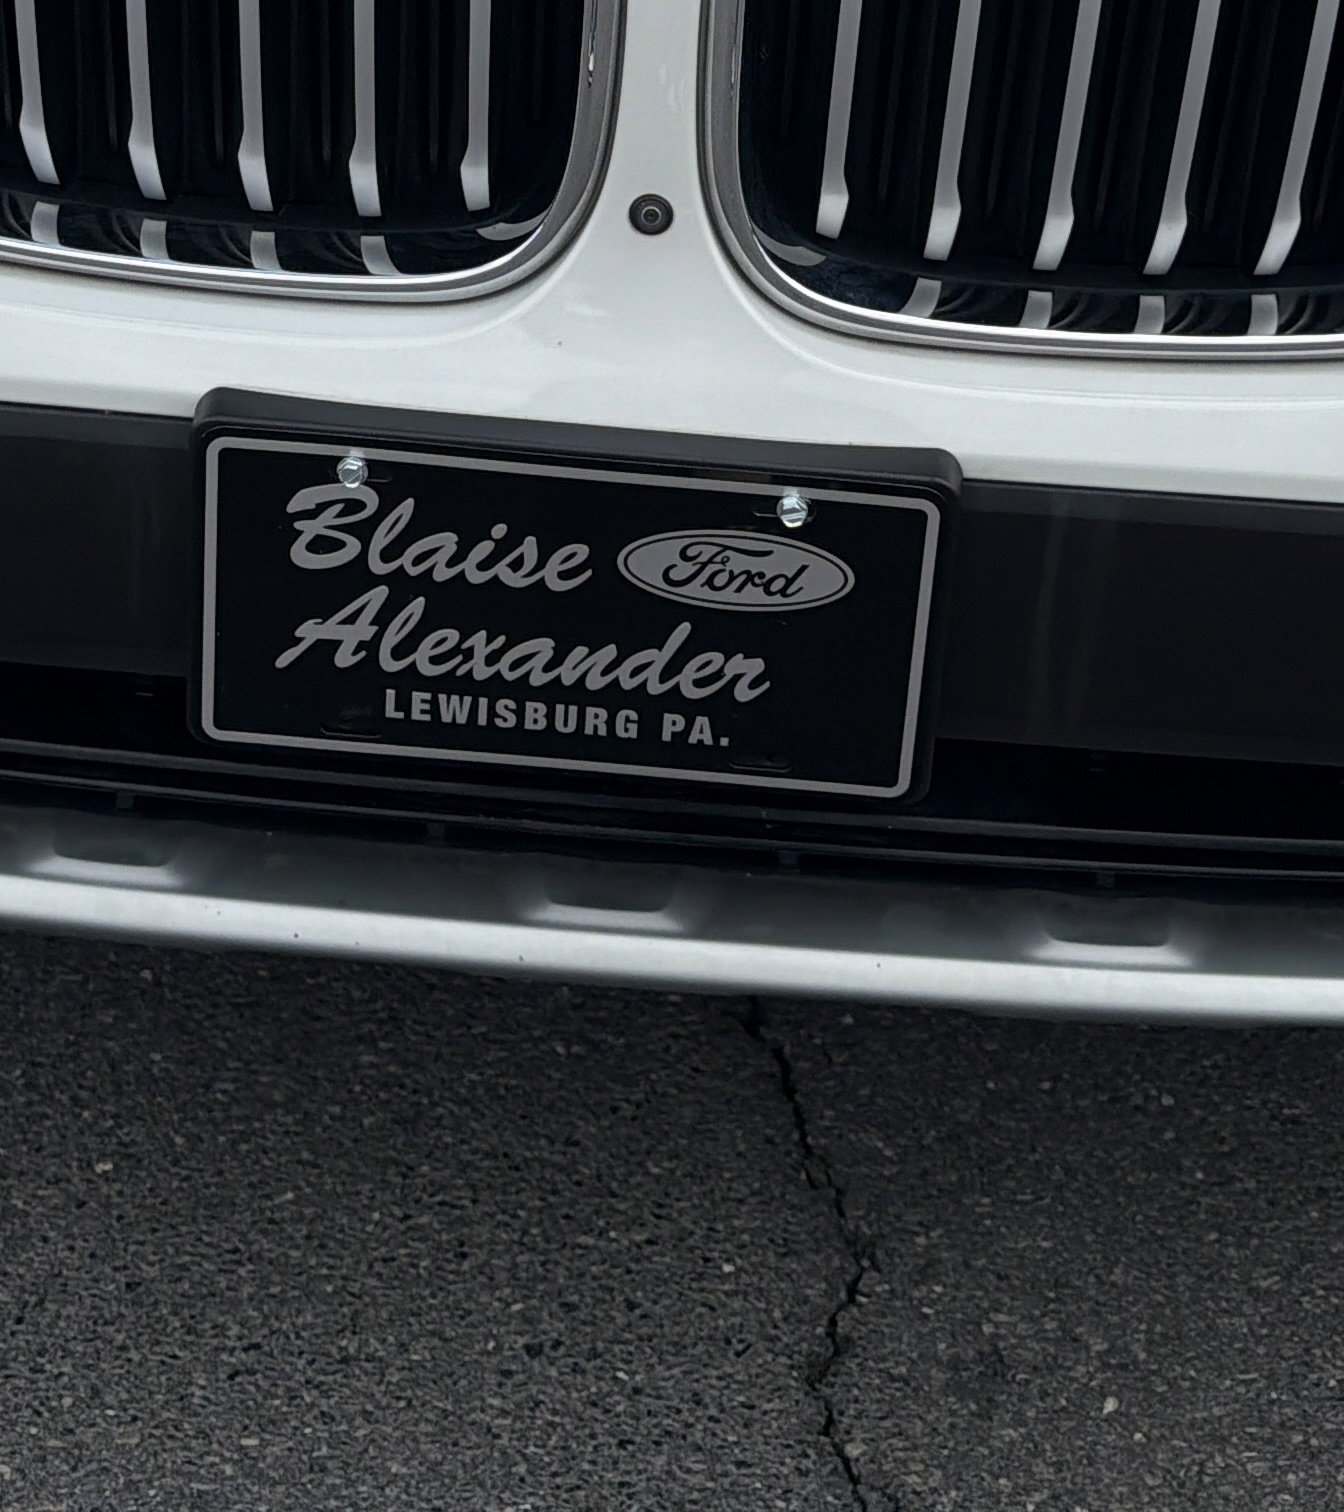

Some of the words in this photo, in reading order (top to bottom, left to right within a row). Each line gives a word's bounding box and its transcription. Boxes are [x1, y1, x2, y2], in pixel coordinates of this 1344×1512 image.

[285, 484, 593, 592] Blaise
[661, 541, 810, 599] Ford
[274, 584, 771, 703] Alexander
[385, 688, 639, 739] LEWISBURG
[661, 712, 732, 748] PA.
